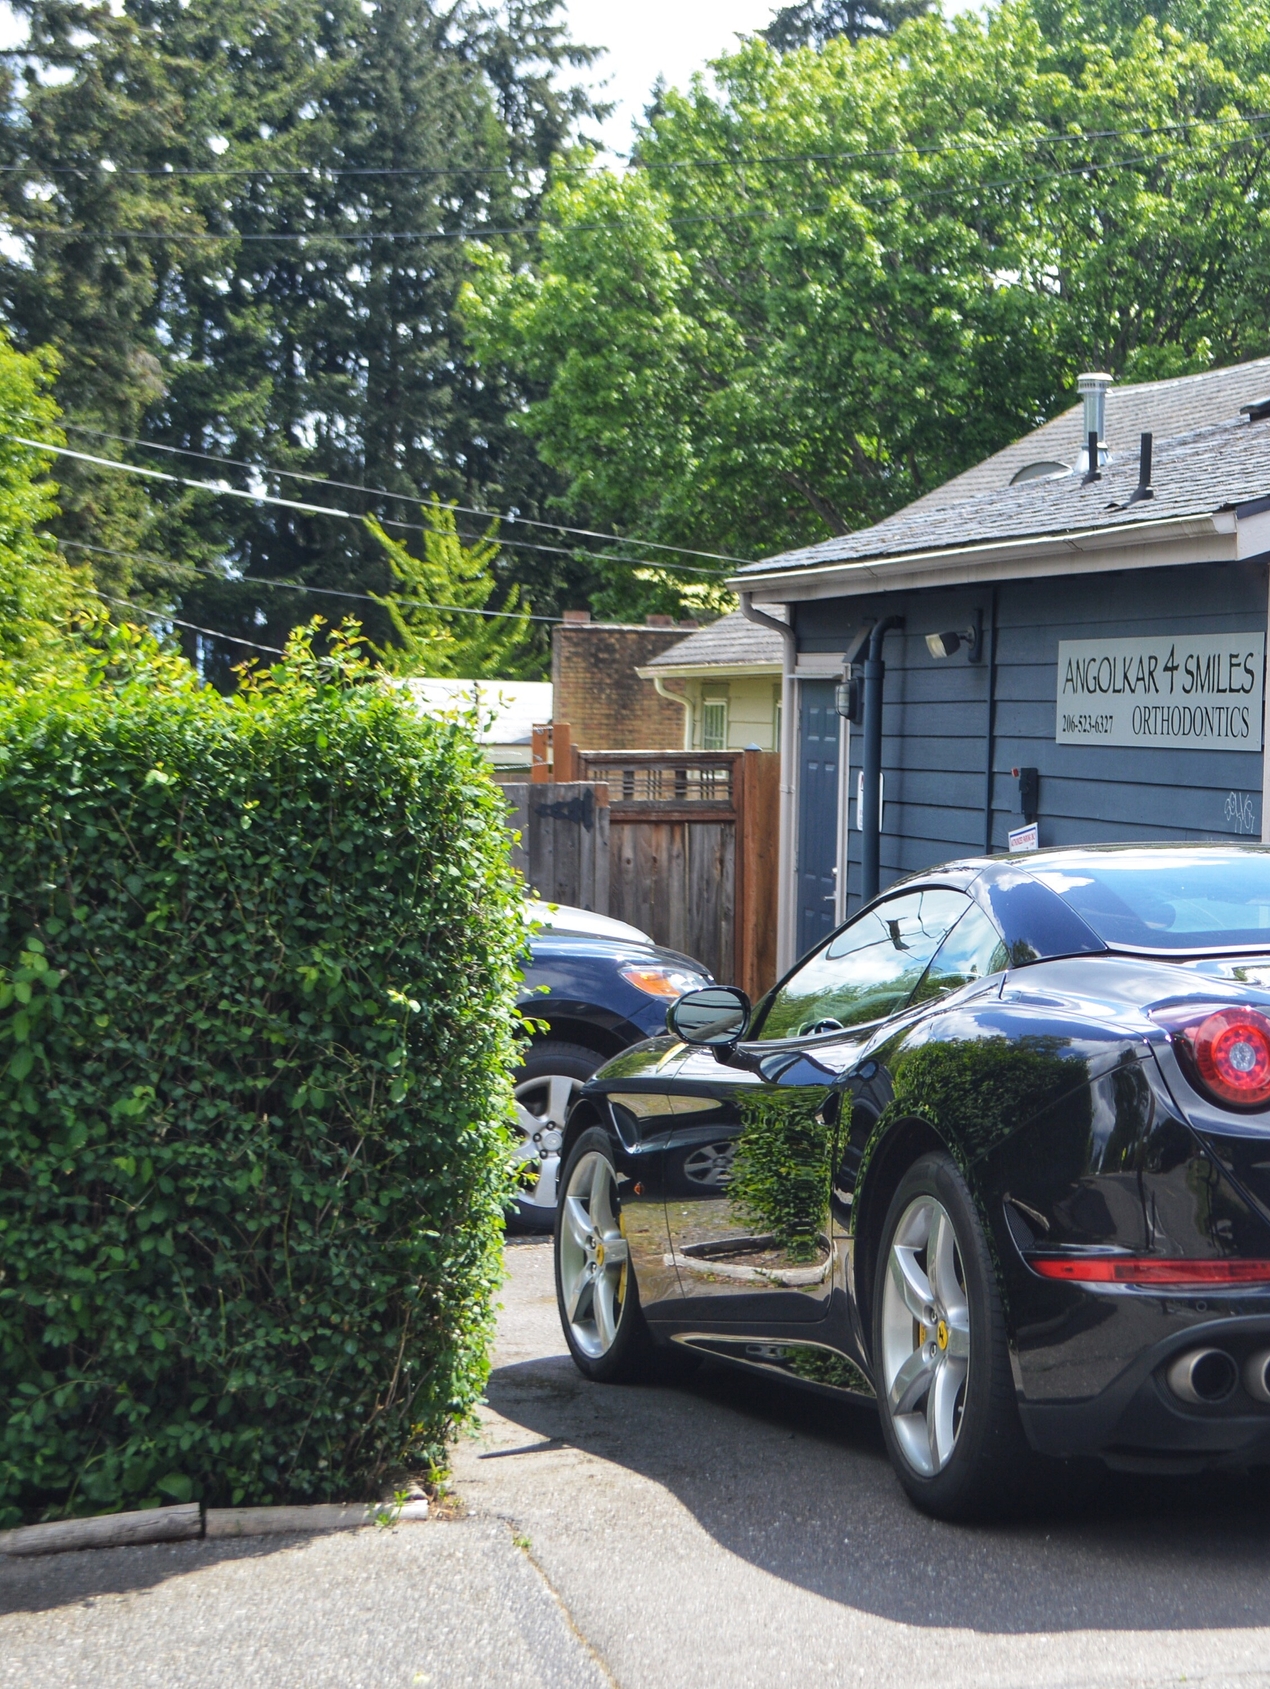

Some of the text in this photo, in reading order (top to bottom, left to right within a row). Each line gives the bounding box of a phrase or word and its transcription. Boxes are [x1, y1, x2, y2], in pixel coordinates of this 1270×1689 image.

[1063, 643, 1255, 694] ANGOLKAR 4 SMILES
[1062, 705, 1250, 738] 206-523-6327 ORTHODONTICS
